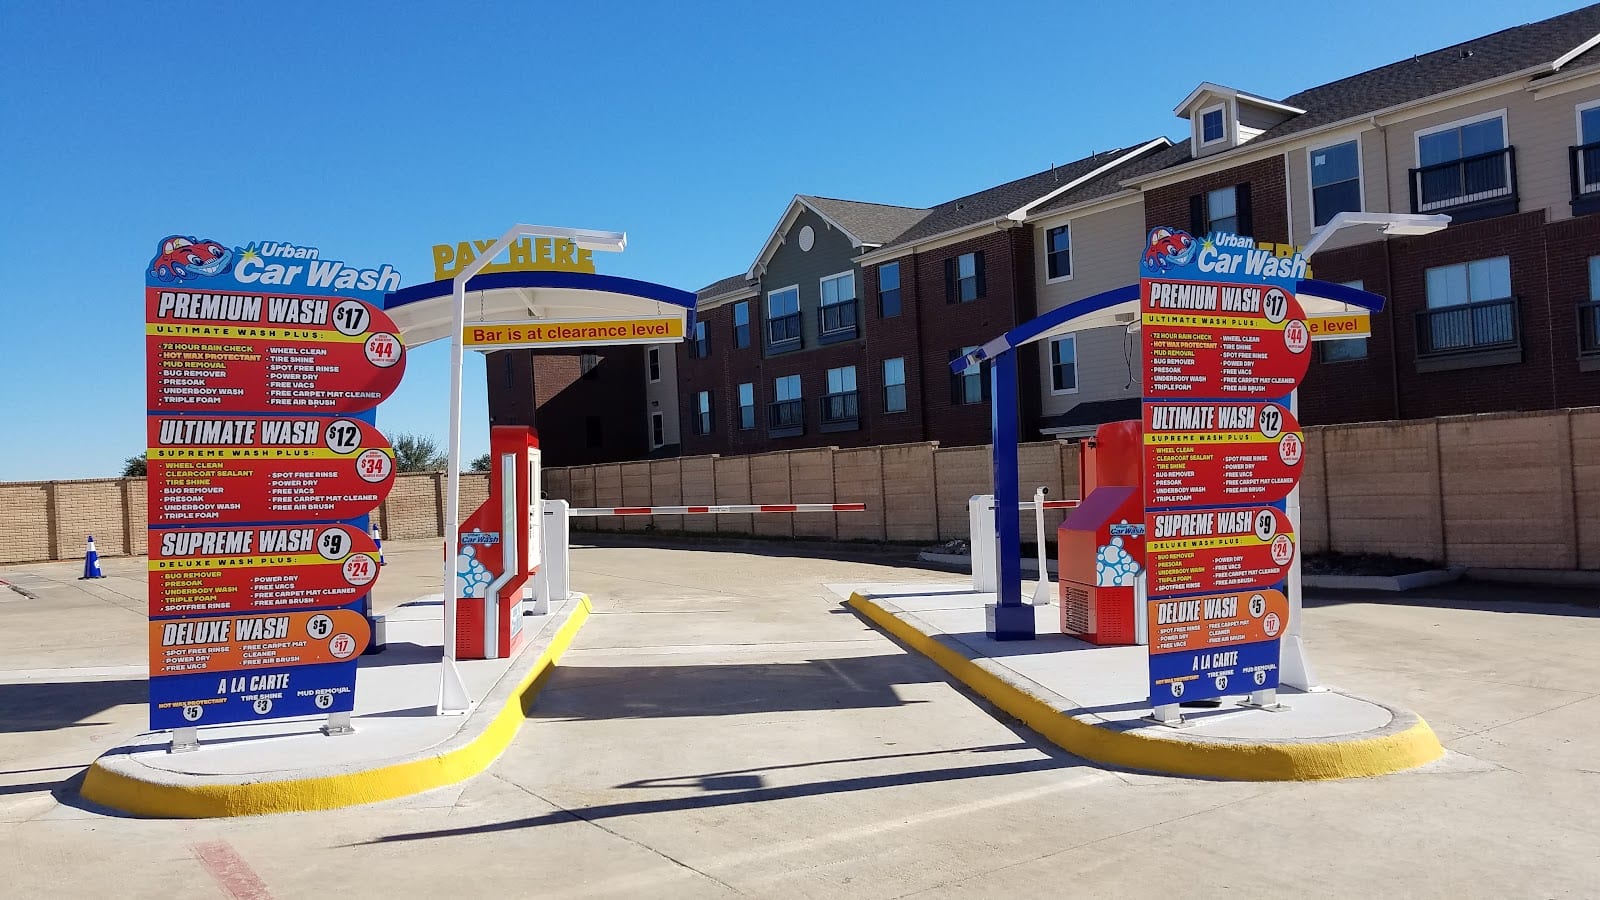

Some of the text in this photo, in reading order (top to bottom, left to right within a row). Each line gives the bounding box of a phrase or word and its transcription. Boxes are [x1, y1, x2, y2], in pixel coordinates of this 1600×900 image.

[1216, 233, 1252, 248] Urban
[261, 243, 319, 260] Urban
[432, 238, 593, 271] PAY HERE
[1198, 246, 1243, 273] Car
[1244, 250, 1307, 278] Wash
[234, 257, 401, 291] Car Wash
[1150, 282, 1284, 316] PREMIUM WASH $17
[159, 292, 364, 330] PREMIUM WASH $17
[157, 327, 229, 335] ULTIMATE
[238, 329, 276, 337] WASH
[474, 323, 669, 341] Bar is at clearance level
[1324, 319, 1357, 331] level
[1288, 328, 1303, 344] $44
[370, 342, 392, 357] $44
[1153, 406, 1278, 431] ULTIMATE WASH $12
[160, 420, 357, 447] ULTIMATE WASH $12
[1282, 442, 1297, 457] $34
[362, 459, 382, 473] $34
[1155, 511, 1271, 538] SUPREME WASH $9
[161, 529, 341, 556] SUPREME WASH $9
[1273, 543, 1287, 558] $24
[219, 558, 253, 566] WASH
[348, 562, 368, 576] $24
[1157, 597, 1261, 625] DELUXE WASH $5
[162, 617, 327, 646] DELUXE WASH $5
[335, 640, 348, 651] $17
[1192, 651, 1238, 671] A LA CARTE
[218, 674, 290, 694] A LA CARTE
[258, 701, 267, 711] $3
[320, 696, 328, 705] $5
[187, 706, 197, 719] $5
